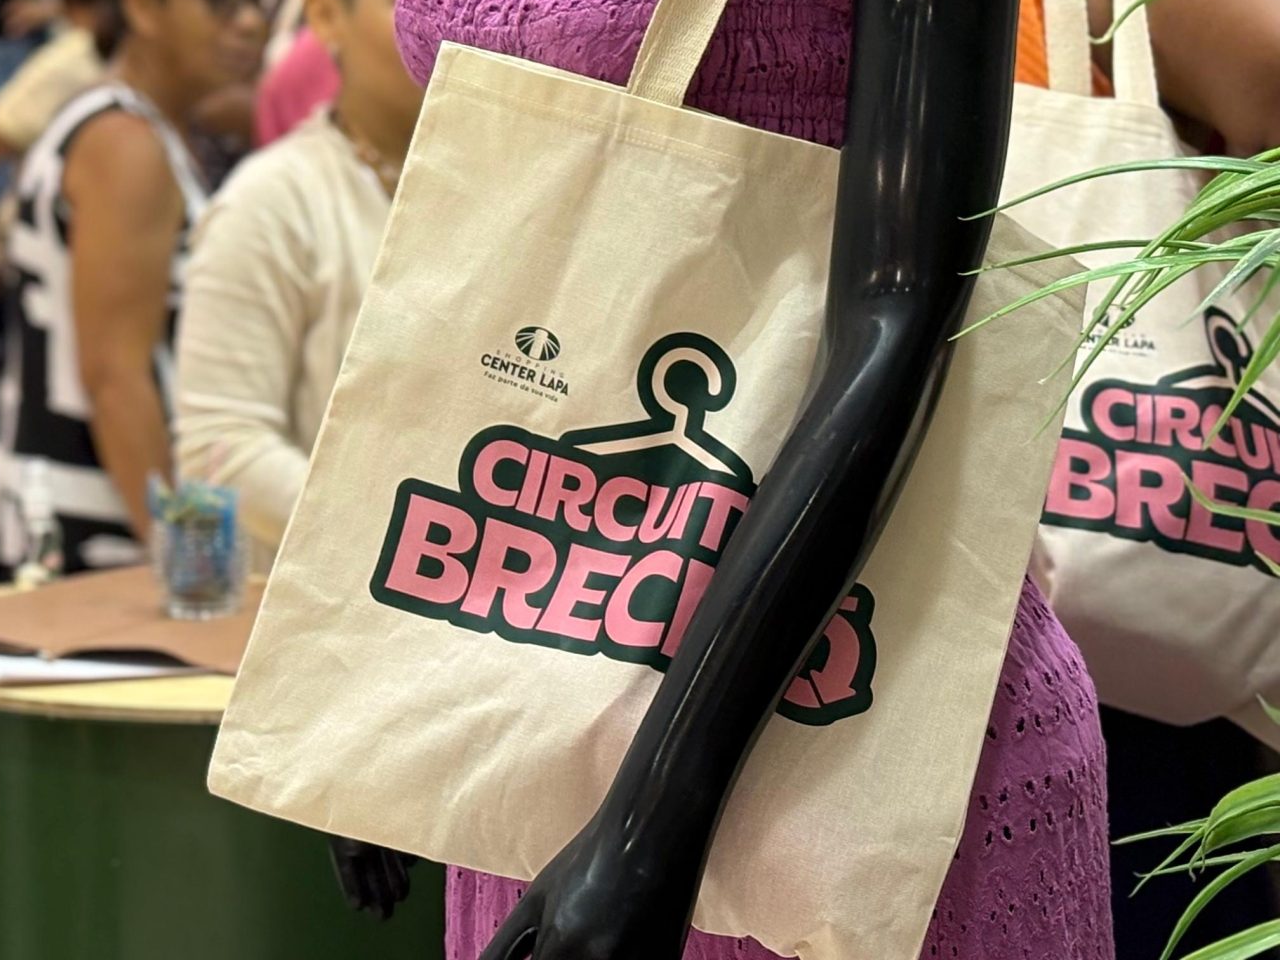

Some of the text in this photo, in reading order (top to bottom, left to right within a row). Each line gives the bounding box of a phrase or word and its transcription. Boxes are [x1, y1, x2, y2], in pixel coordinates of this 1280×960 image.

[1124, 338, 1155, 350] LAPA
[481, 353, 569, 396] CENTER LAPA
[496, 349, 565, 378] SHOPPING
[497, 376, 518, 388] parte
[519, 383, 530, 392] da
[531, 388, 543, 397] sua
[544, 393, 558, 403] vida
[1092, 388, 1280, 474] CIRCUI
[473, 439, 749, 552] CIRCUIT
